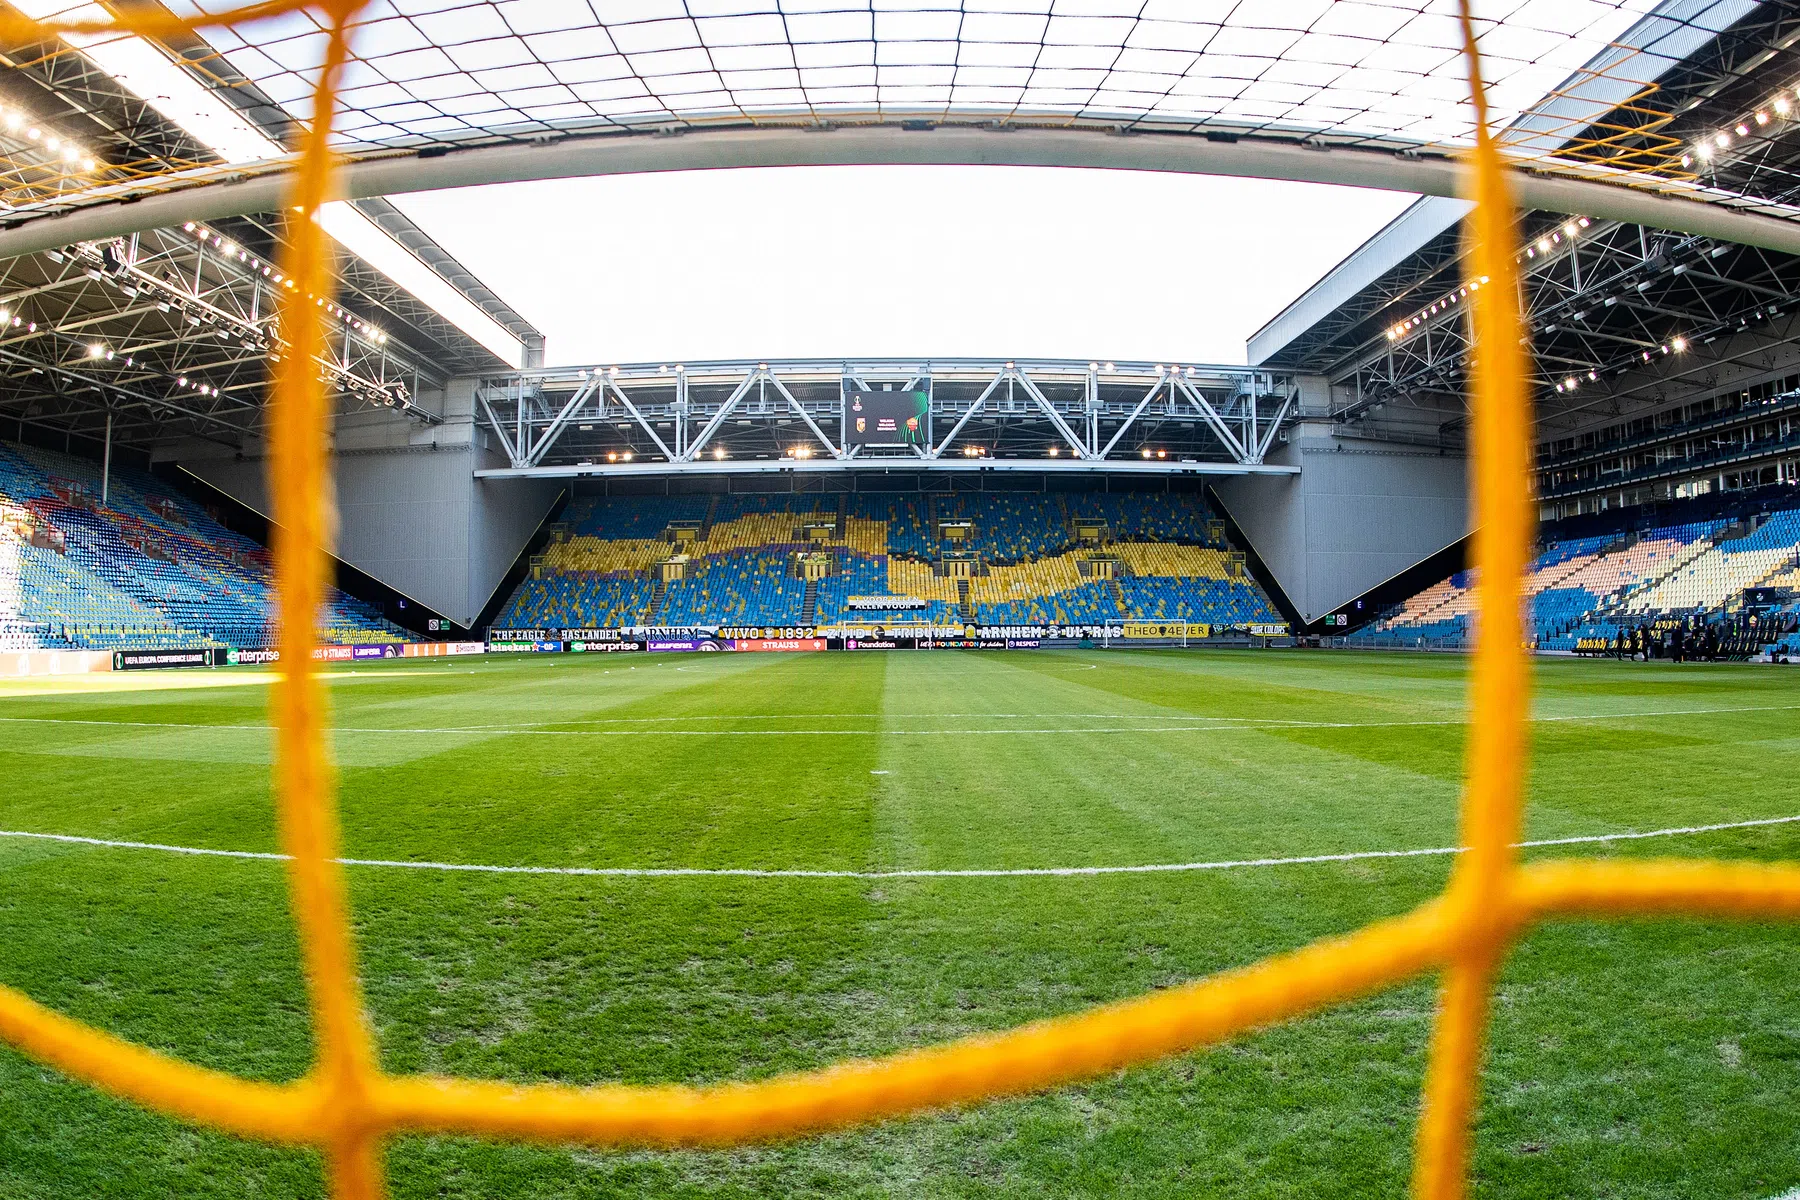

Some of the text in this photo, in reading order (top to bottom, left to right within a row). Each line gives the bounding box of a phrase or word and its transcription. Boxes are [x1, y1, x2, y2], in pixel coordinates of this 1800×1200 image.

[400, 601, 406, 609] L
[1357, 601, 1362, 609] E
[495, 629, 618, 640] THE EAGLE HAS LANDED
[642, 628, 700, 641] ARNHEM
[722, 627, 814, 639] VIVO 1892
[826, 627, 955, 639] ZUID TRIBUNE
[980, 626, 1043, 639] ARNHEM
[1065, 626, 1121, 638] ULTRAS
[1126, 626, 1158, 635] THEO
[571, 641, 640, 652] enterprise
[762, 641, 800, 649] STRAUSS
[227, 648, 280, 664] enterprise
[328, 648, 351, 658] STRAUSS
[124, 653, 204, 665] UEFA EUROPA CONFERENCE LEAGUE
